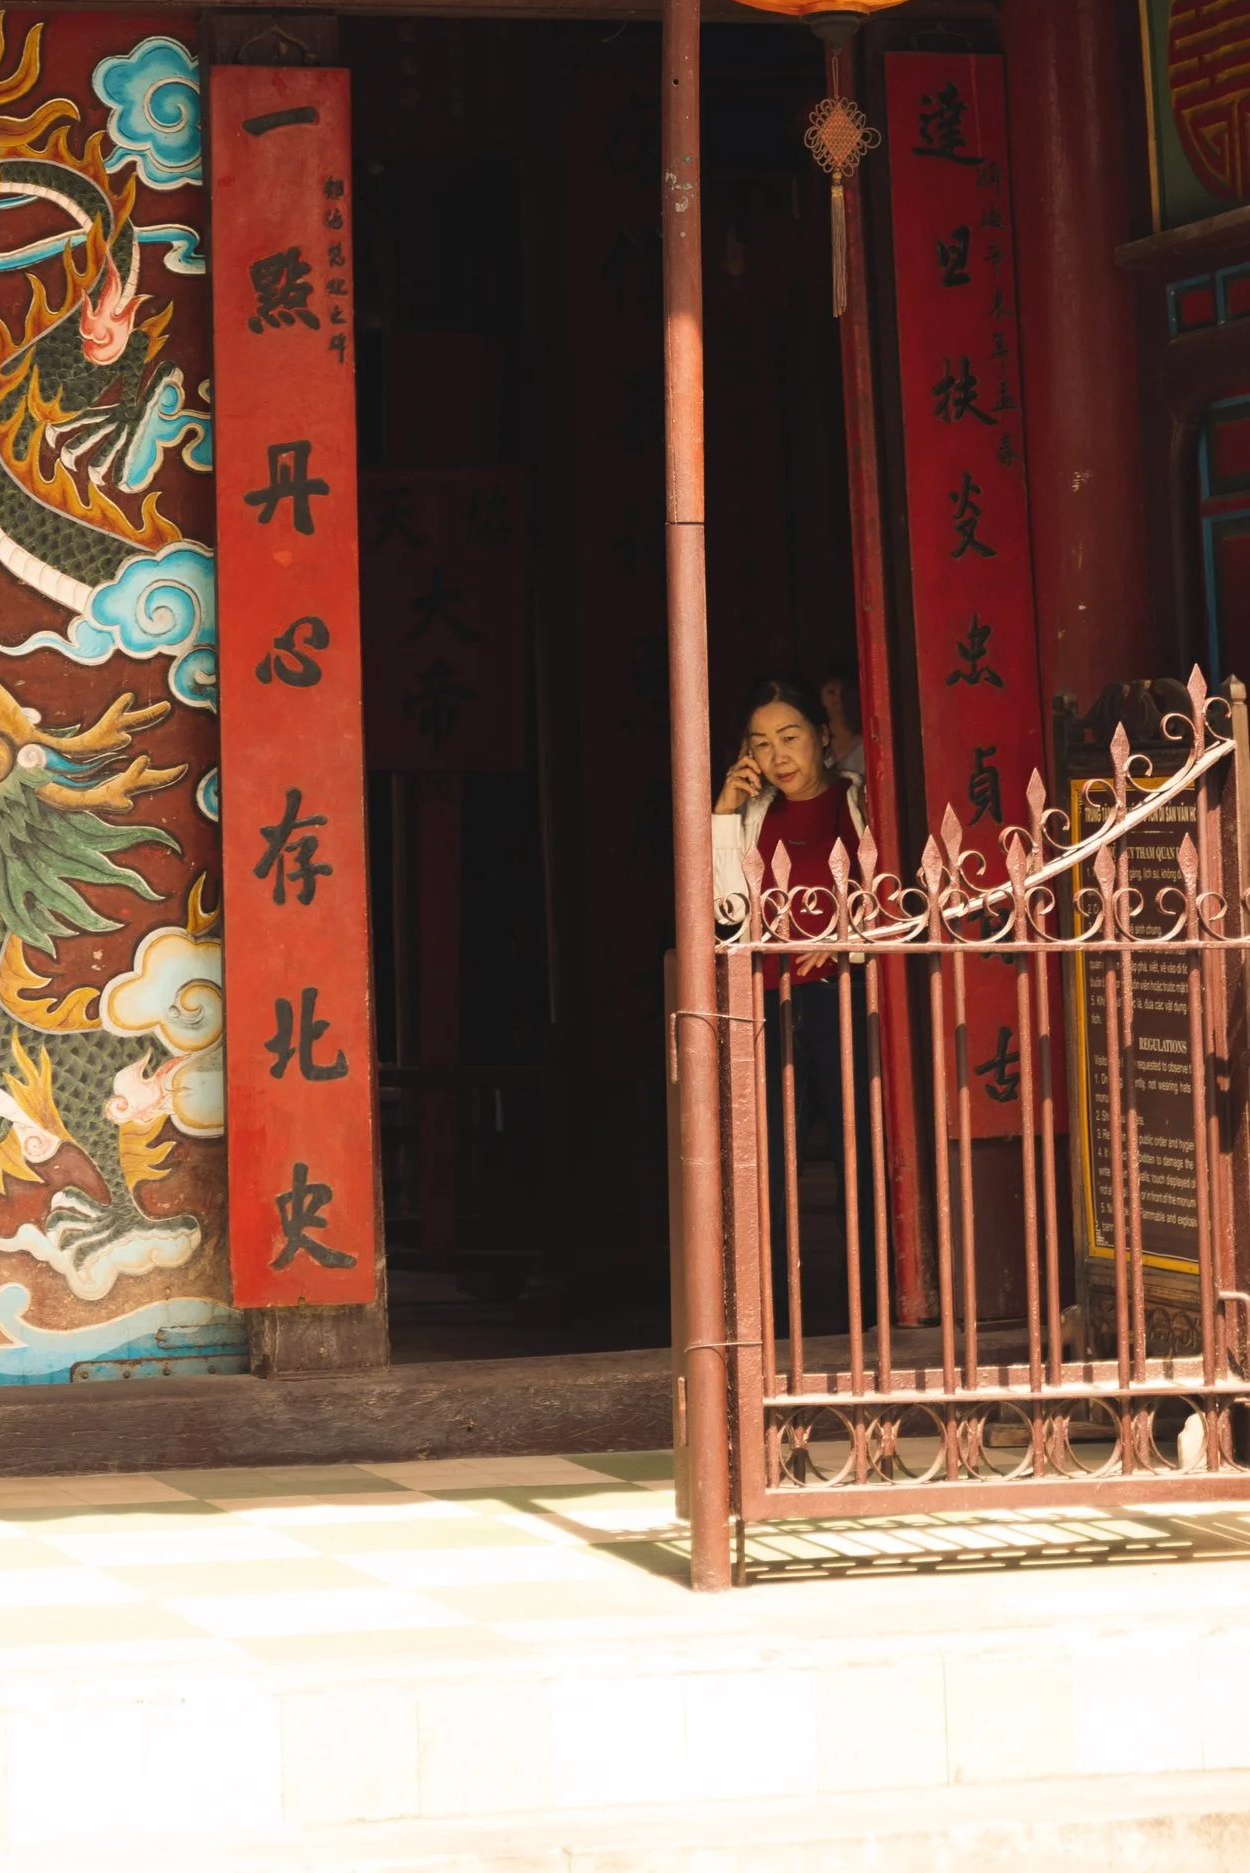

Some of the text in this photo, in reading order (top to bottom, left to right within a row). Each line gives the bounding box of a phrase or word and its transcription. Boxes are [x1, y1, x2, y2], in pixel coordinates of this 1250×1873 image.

[1136, 846, 1155, 859] THAM
[1156, 846, 1175, 862] QUAN
[1139, 1037, 1188, 1054] REGULATIONS
